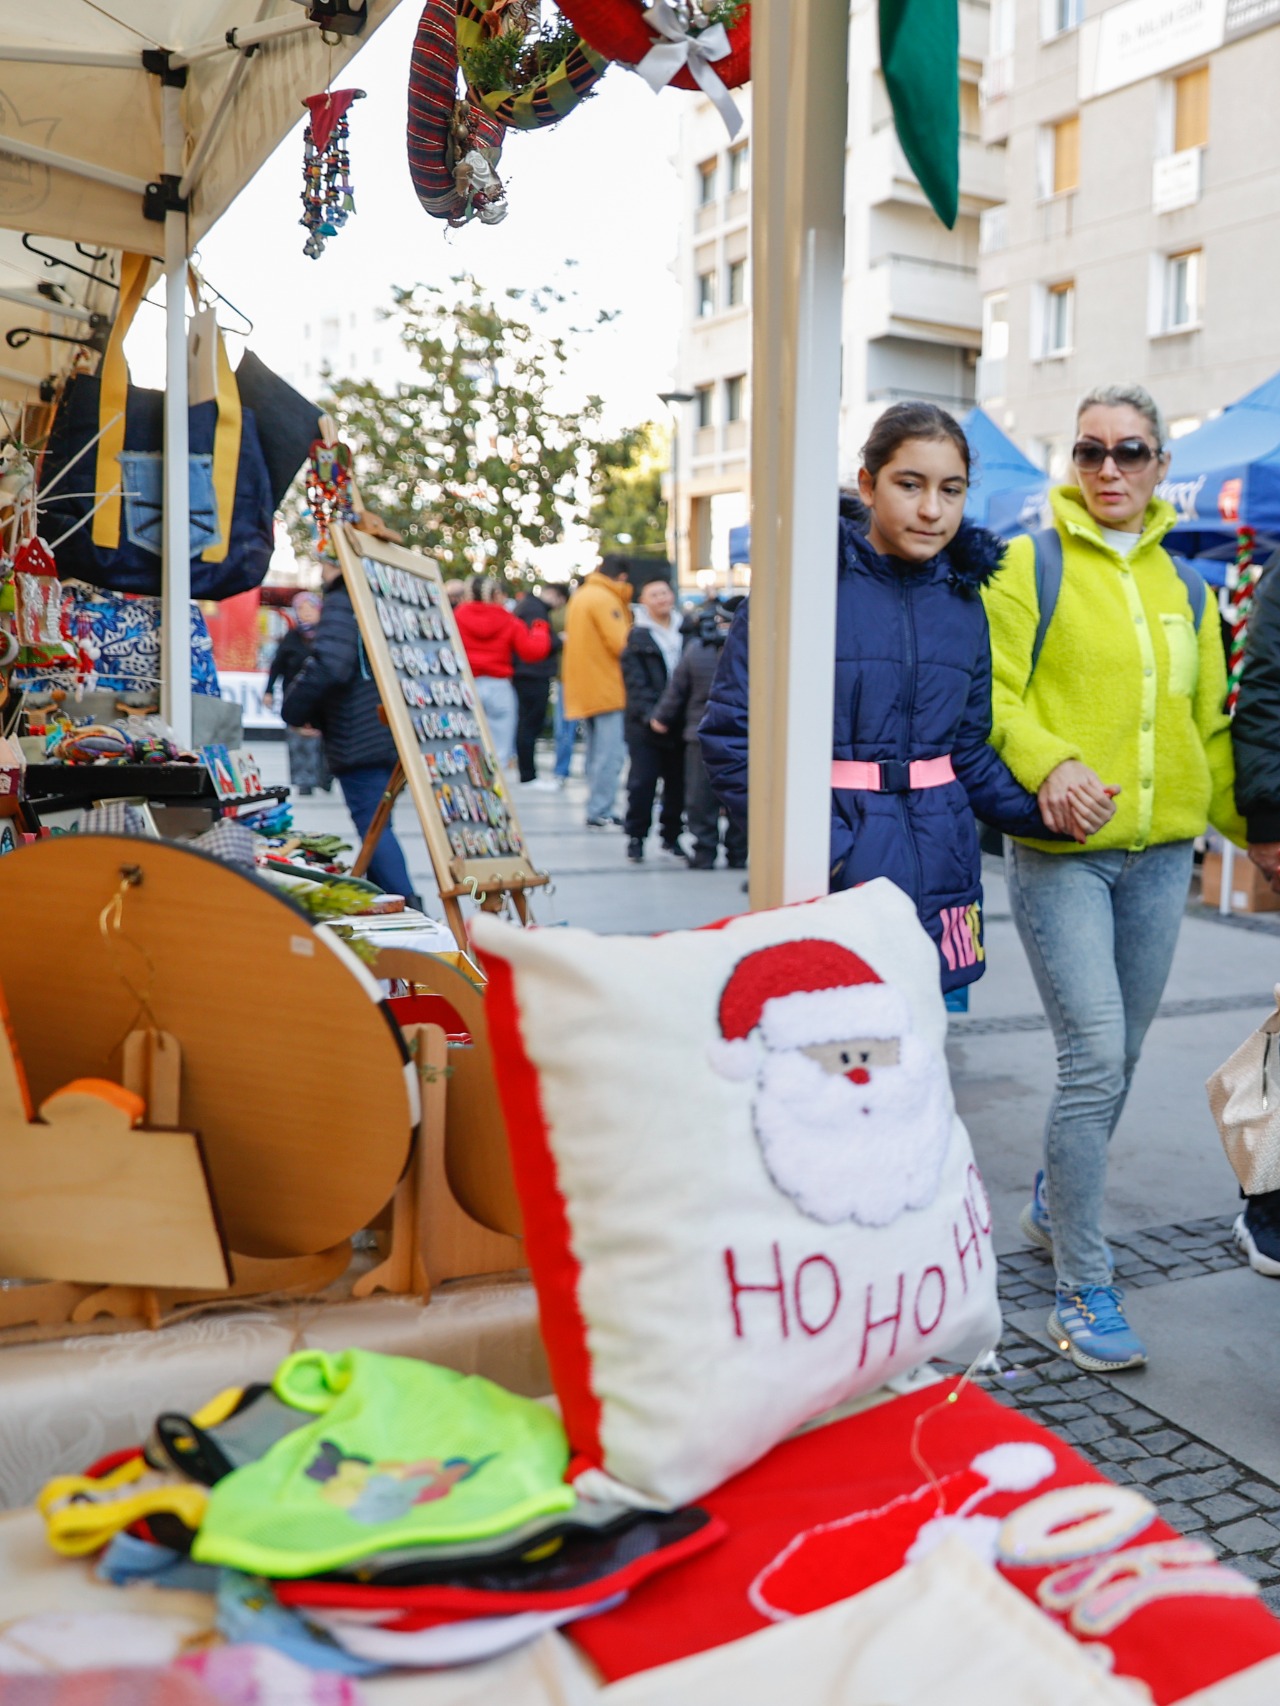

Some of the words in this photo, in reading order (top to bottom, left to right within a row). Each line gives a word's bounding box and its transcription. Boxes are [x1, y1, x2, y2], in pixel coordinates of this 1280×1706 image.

[724, 1240, 842, 1339] HO
[858, 1265, 946, 1369] HO
[953, 1162, 992, 1294] HO
